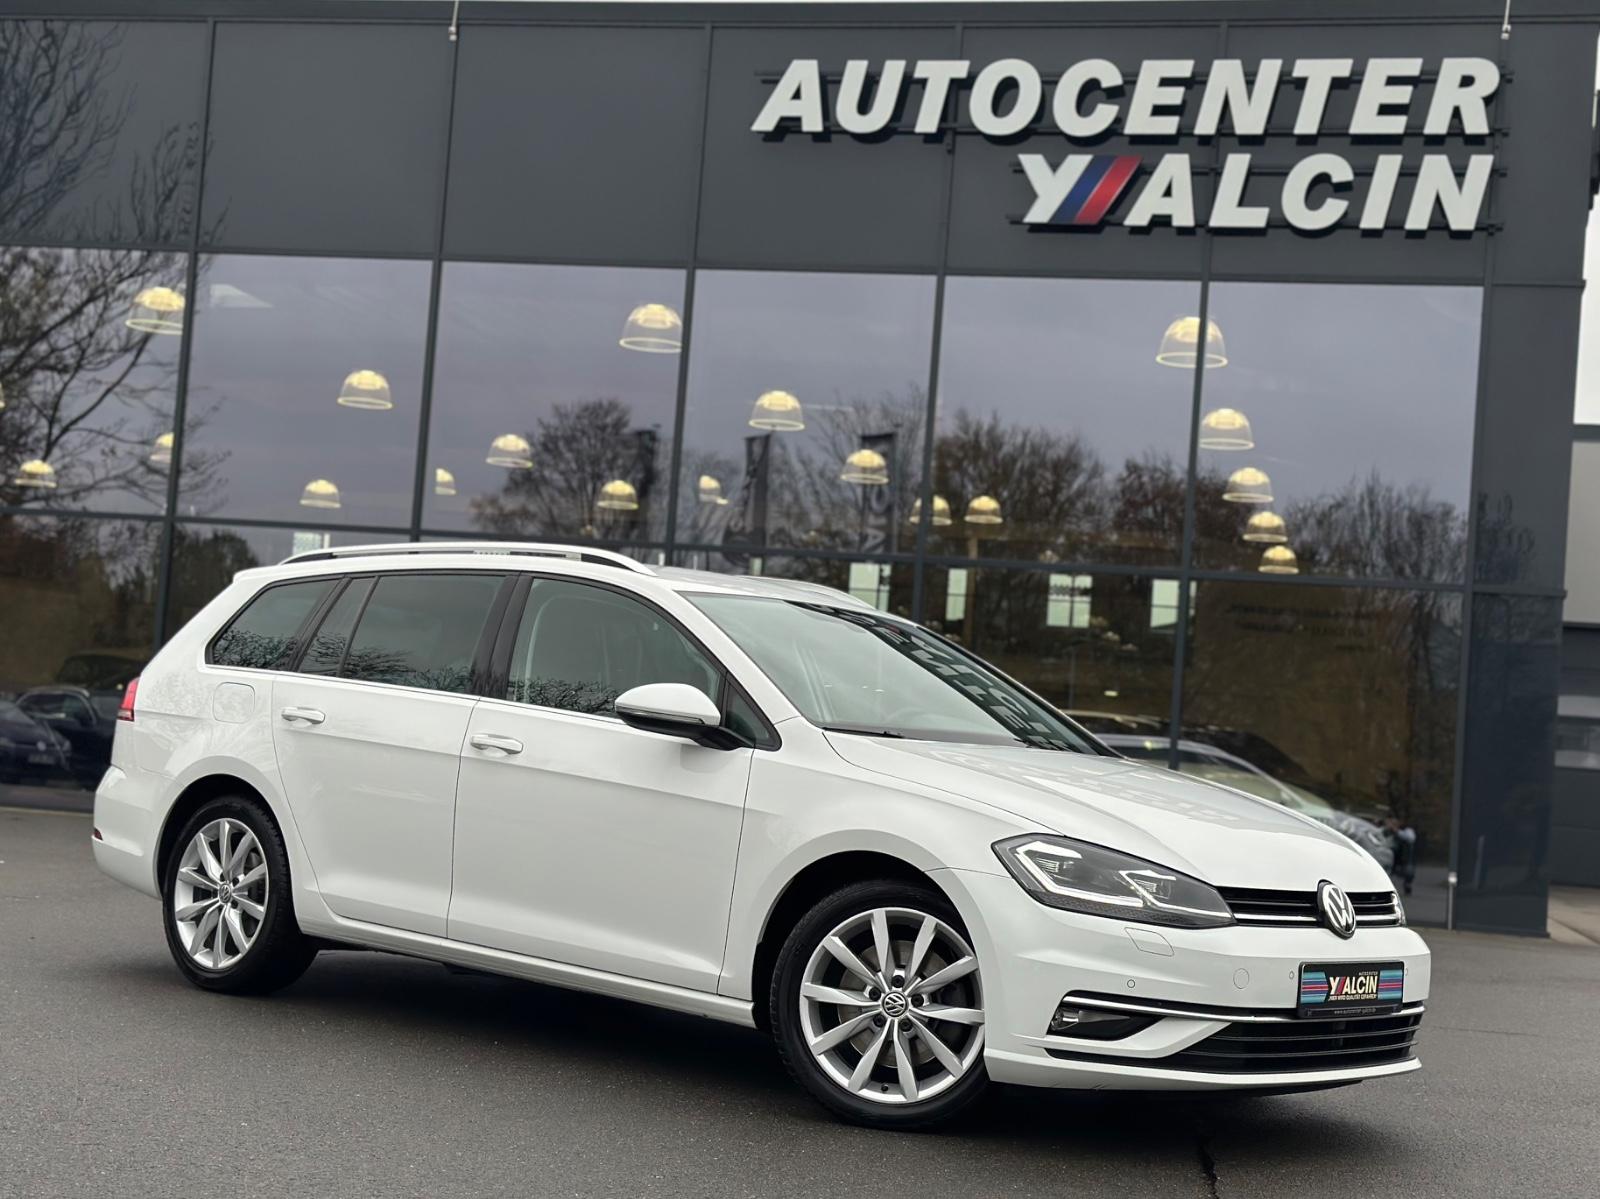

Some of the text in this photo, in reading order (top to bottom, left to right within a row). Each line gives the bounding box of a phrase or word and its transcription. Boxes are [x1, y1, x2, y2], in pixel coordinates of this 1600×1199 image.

[751, 57, 1500, 137] AUTOCENTER
[1018, 153, 1495, 231] YALCIN
[1322, 883, 1356, 934] VW
[884, 994, 906, 1015] VW
[1329, 976, 1378, 995] YALCIN
